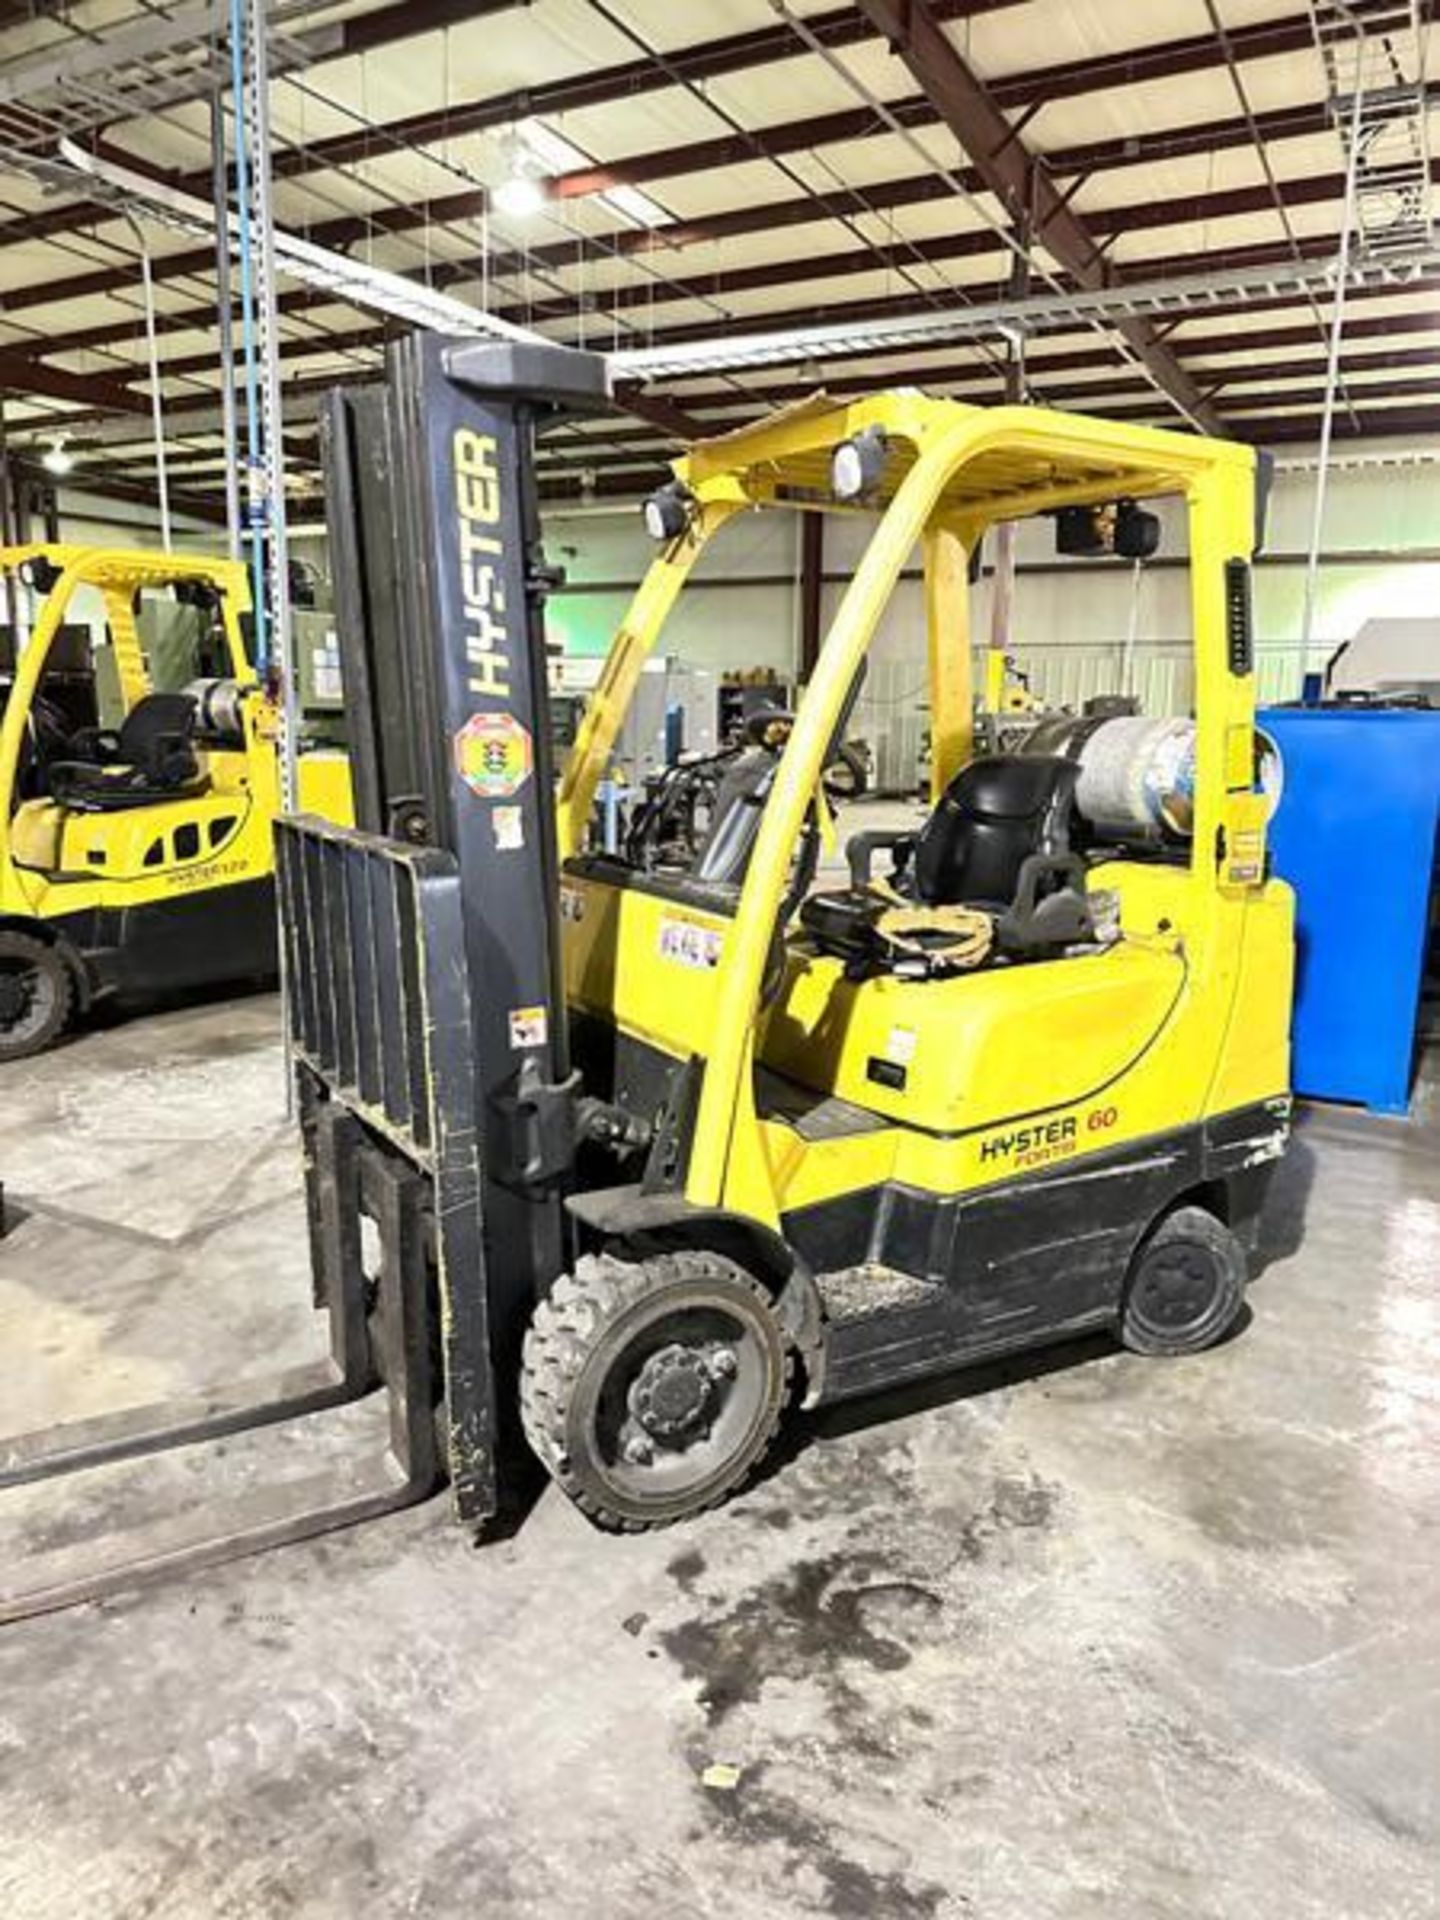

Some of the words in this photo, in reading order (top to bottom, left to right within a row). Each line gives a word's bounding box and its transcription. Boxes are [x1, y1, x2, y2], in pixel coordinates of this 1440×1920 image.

[453, 428, 510, 697] HYSTER
[980, 1116, 1078, 1163] HYSTER
[1087, 1106, 1118, 1131] 60
